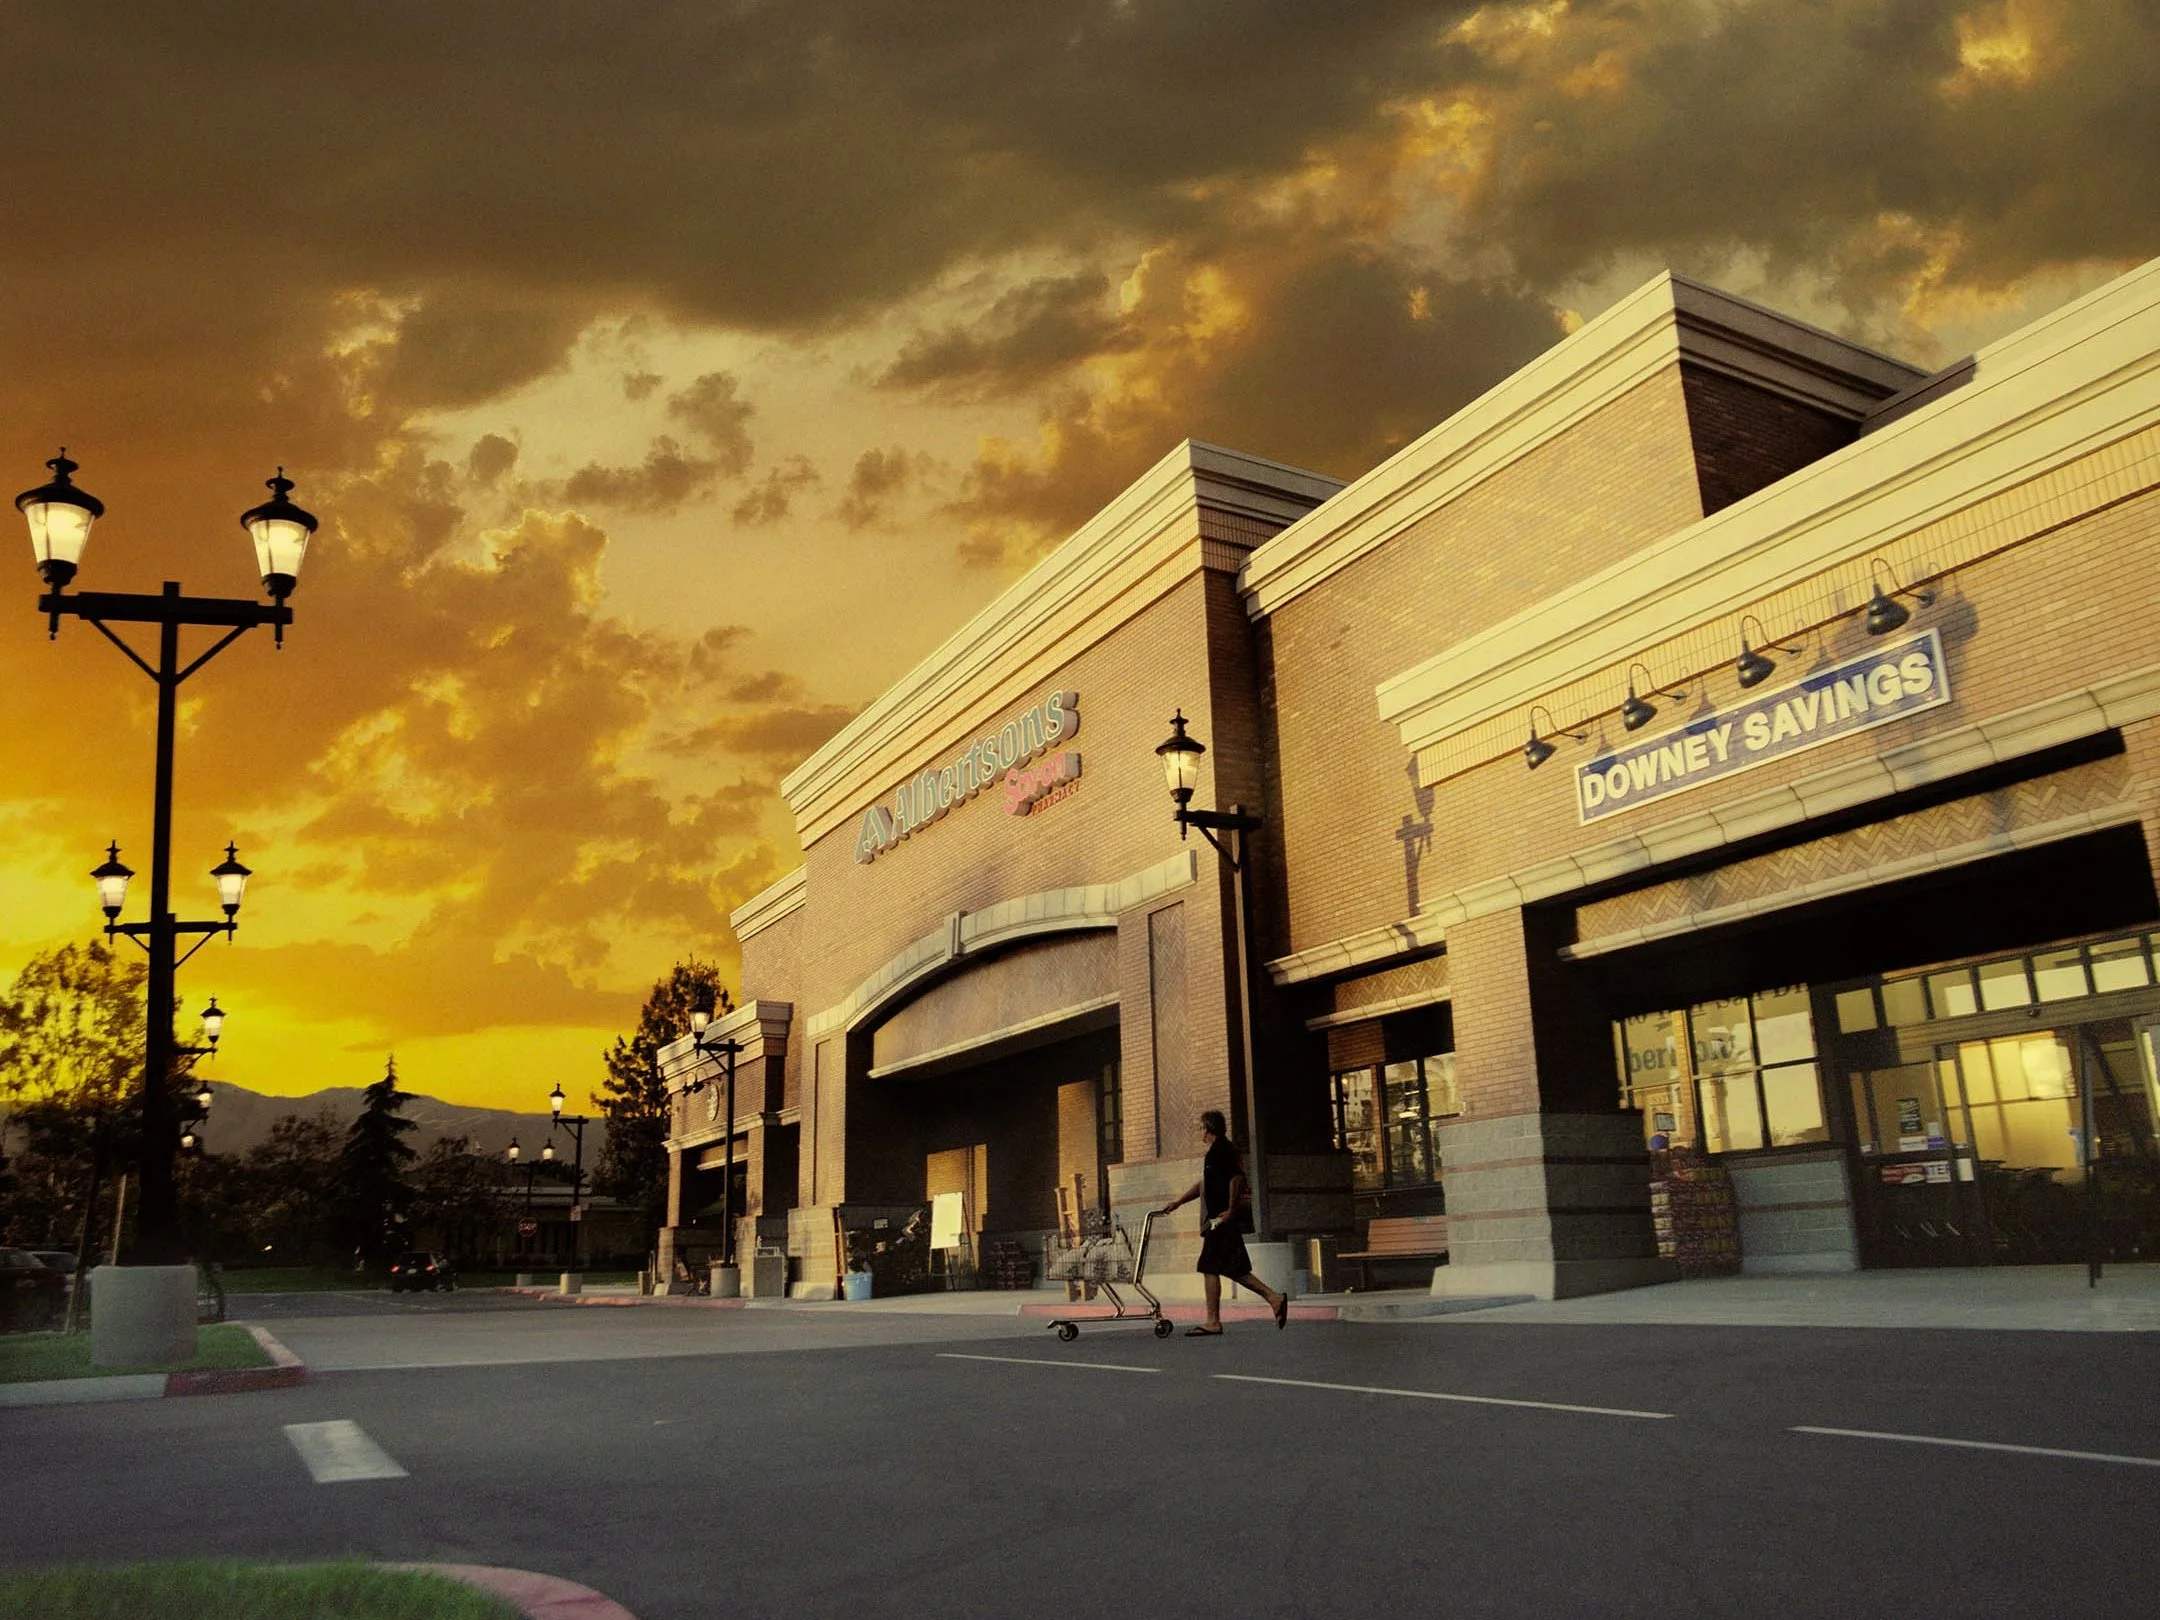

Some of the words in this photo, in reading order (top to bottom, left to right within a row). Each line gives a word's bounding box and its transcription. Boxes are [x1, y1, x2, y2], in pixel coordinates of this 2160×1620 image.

[892, 689, 1072, 841] Albertsons
[1582, 721, 1735, 810] DOWNEY
[1743, 650, 1935, 752] SAVINGS
